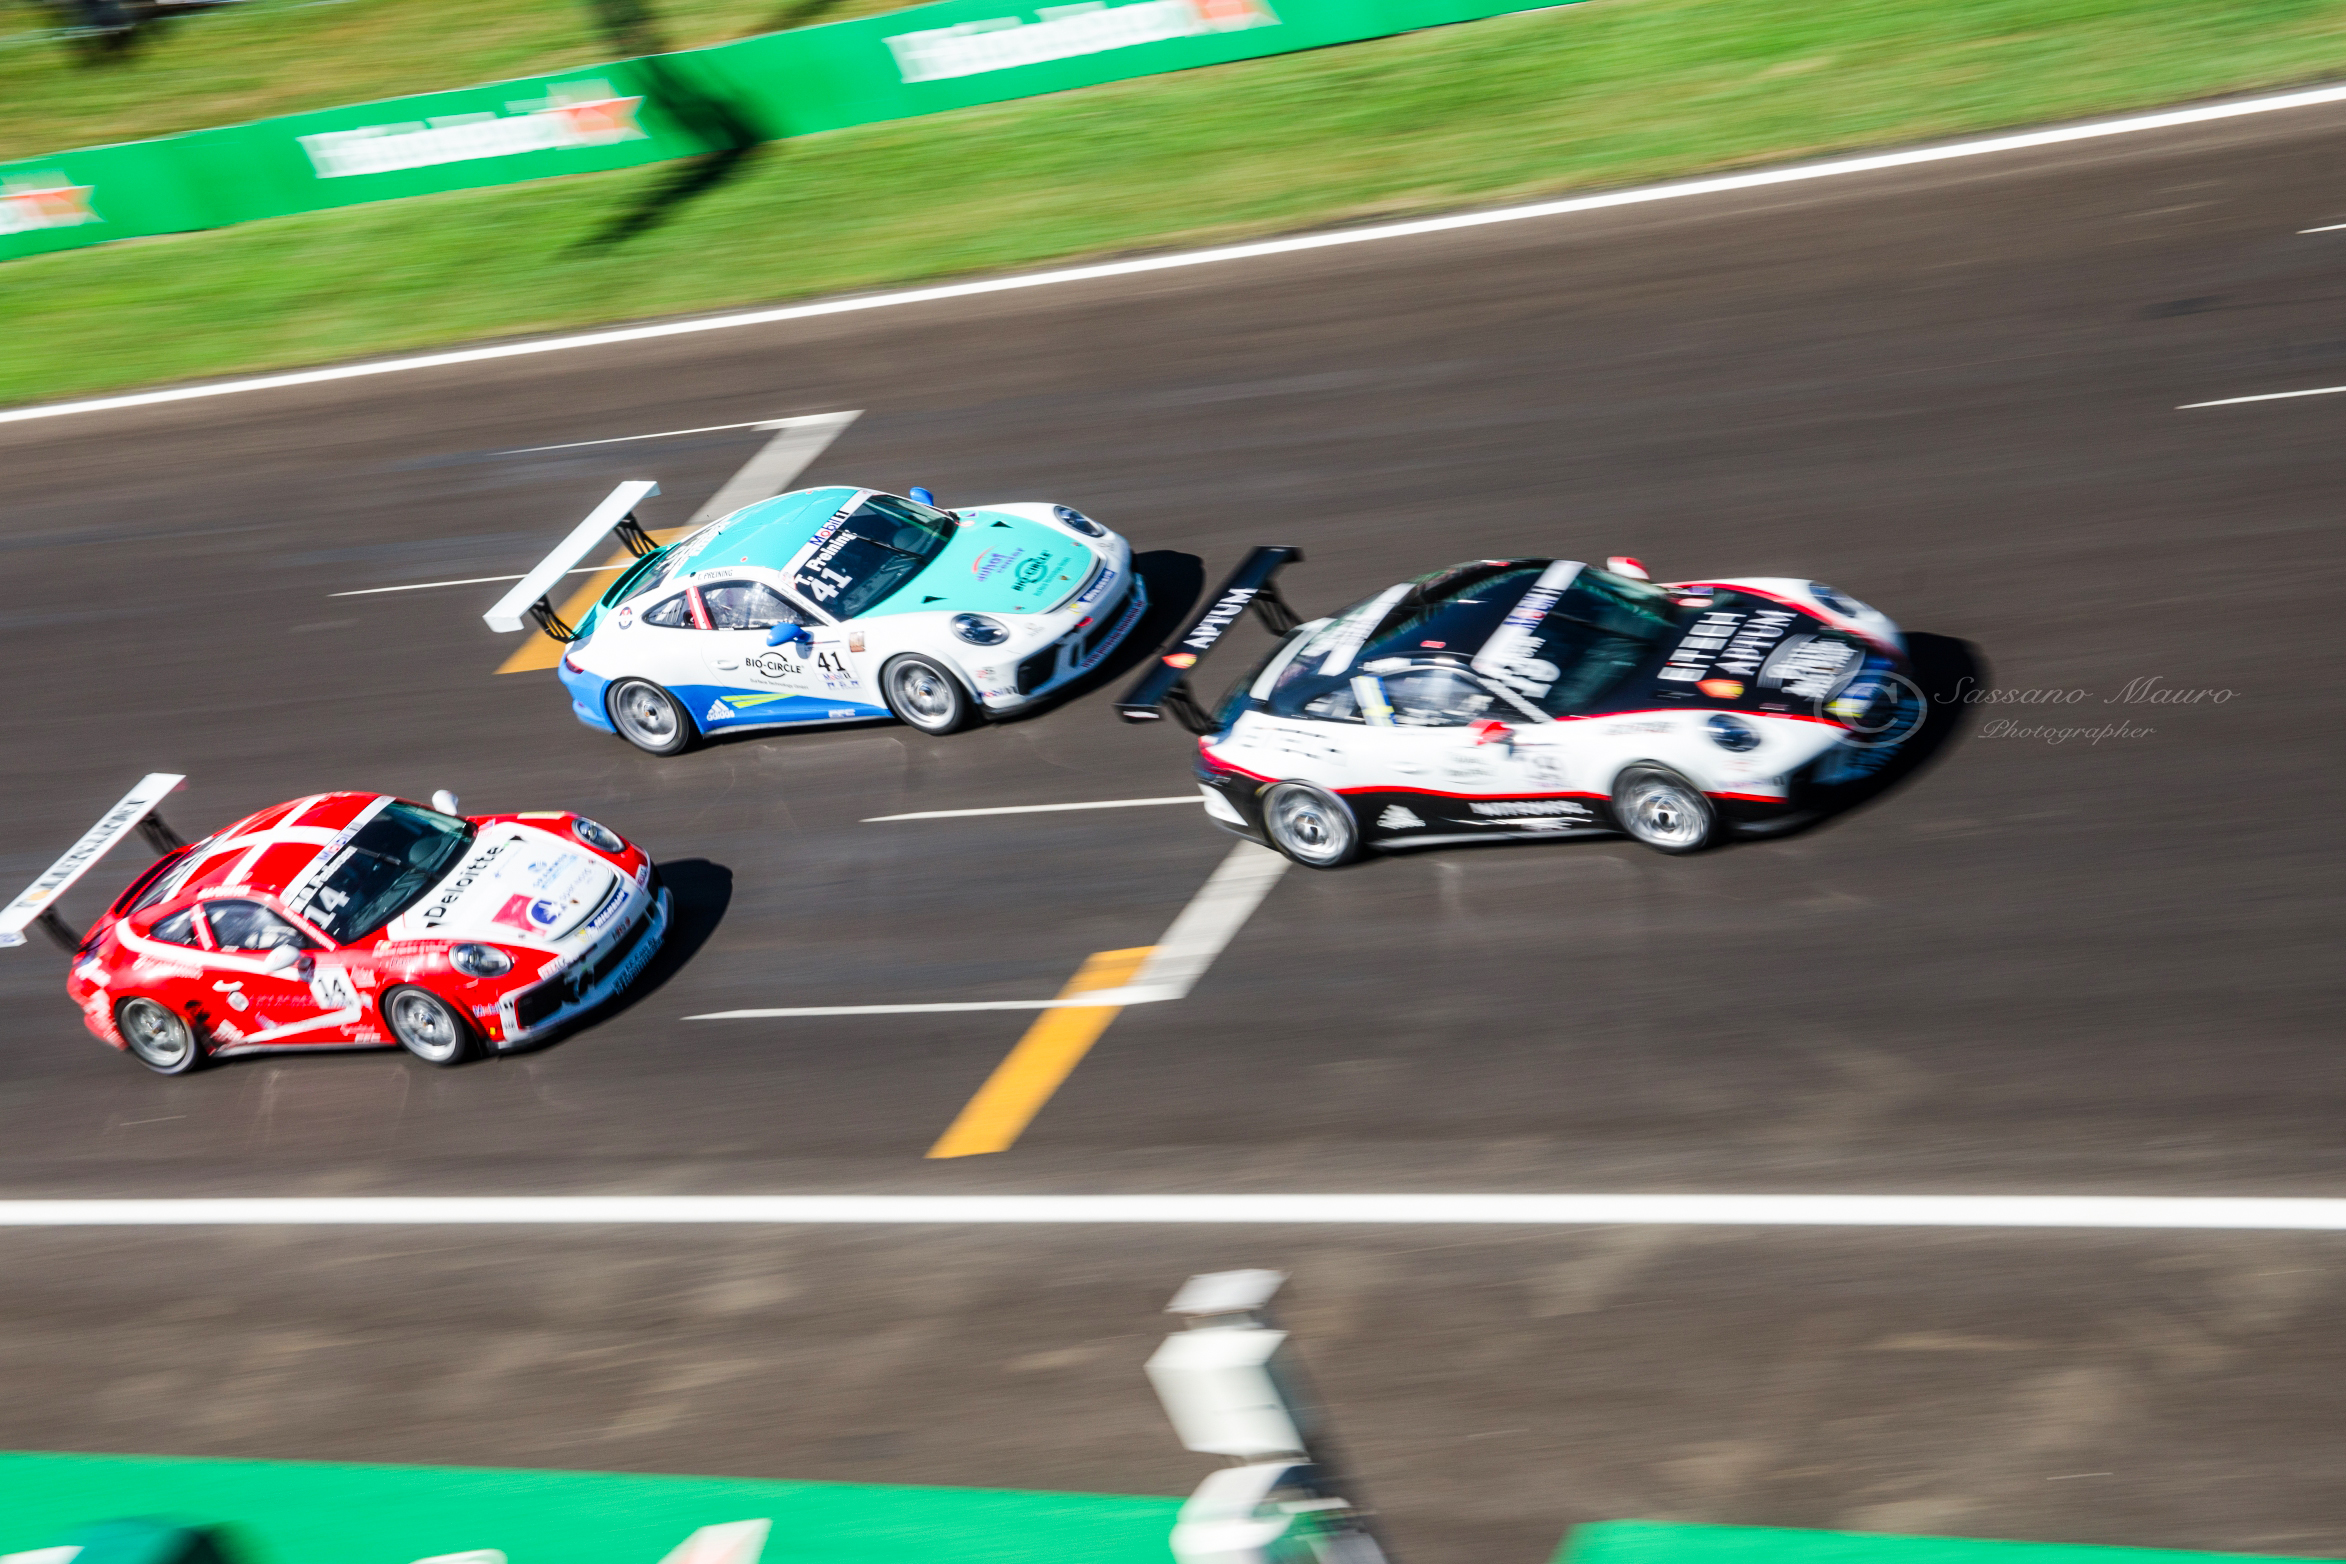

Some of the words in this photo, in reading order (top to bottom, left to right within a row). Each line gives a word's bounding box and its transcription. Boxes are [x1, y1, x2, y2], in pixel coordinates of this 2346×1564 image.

[809, 517, 842, 546] Mobil
[794, 573, 814, 586] T.
[805, 529, 858, 572] Preining
[810, 567, 854, 602] 41
[746, 657, 802, 674] BIO-CIRCLE
[818, 651, 846, 672] 41
[303, 885, 351, 931] 14
[317, 977, 347, 999] 14
